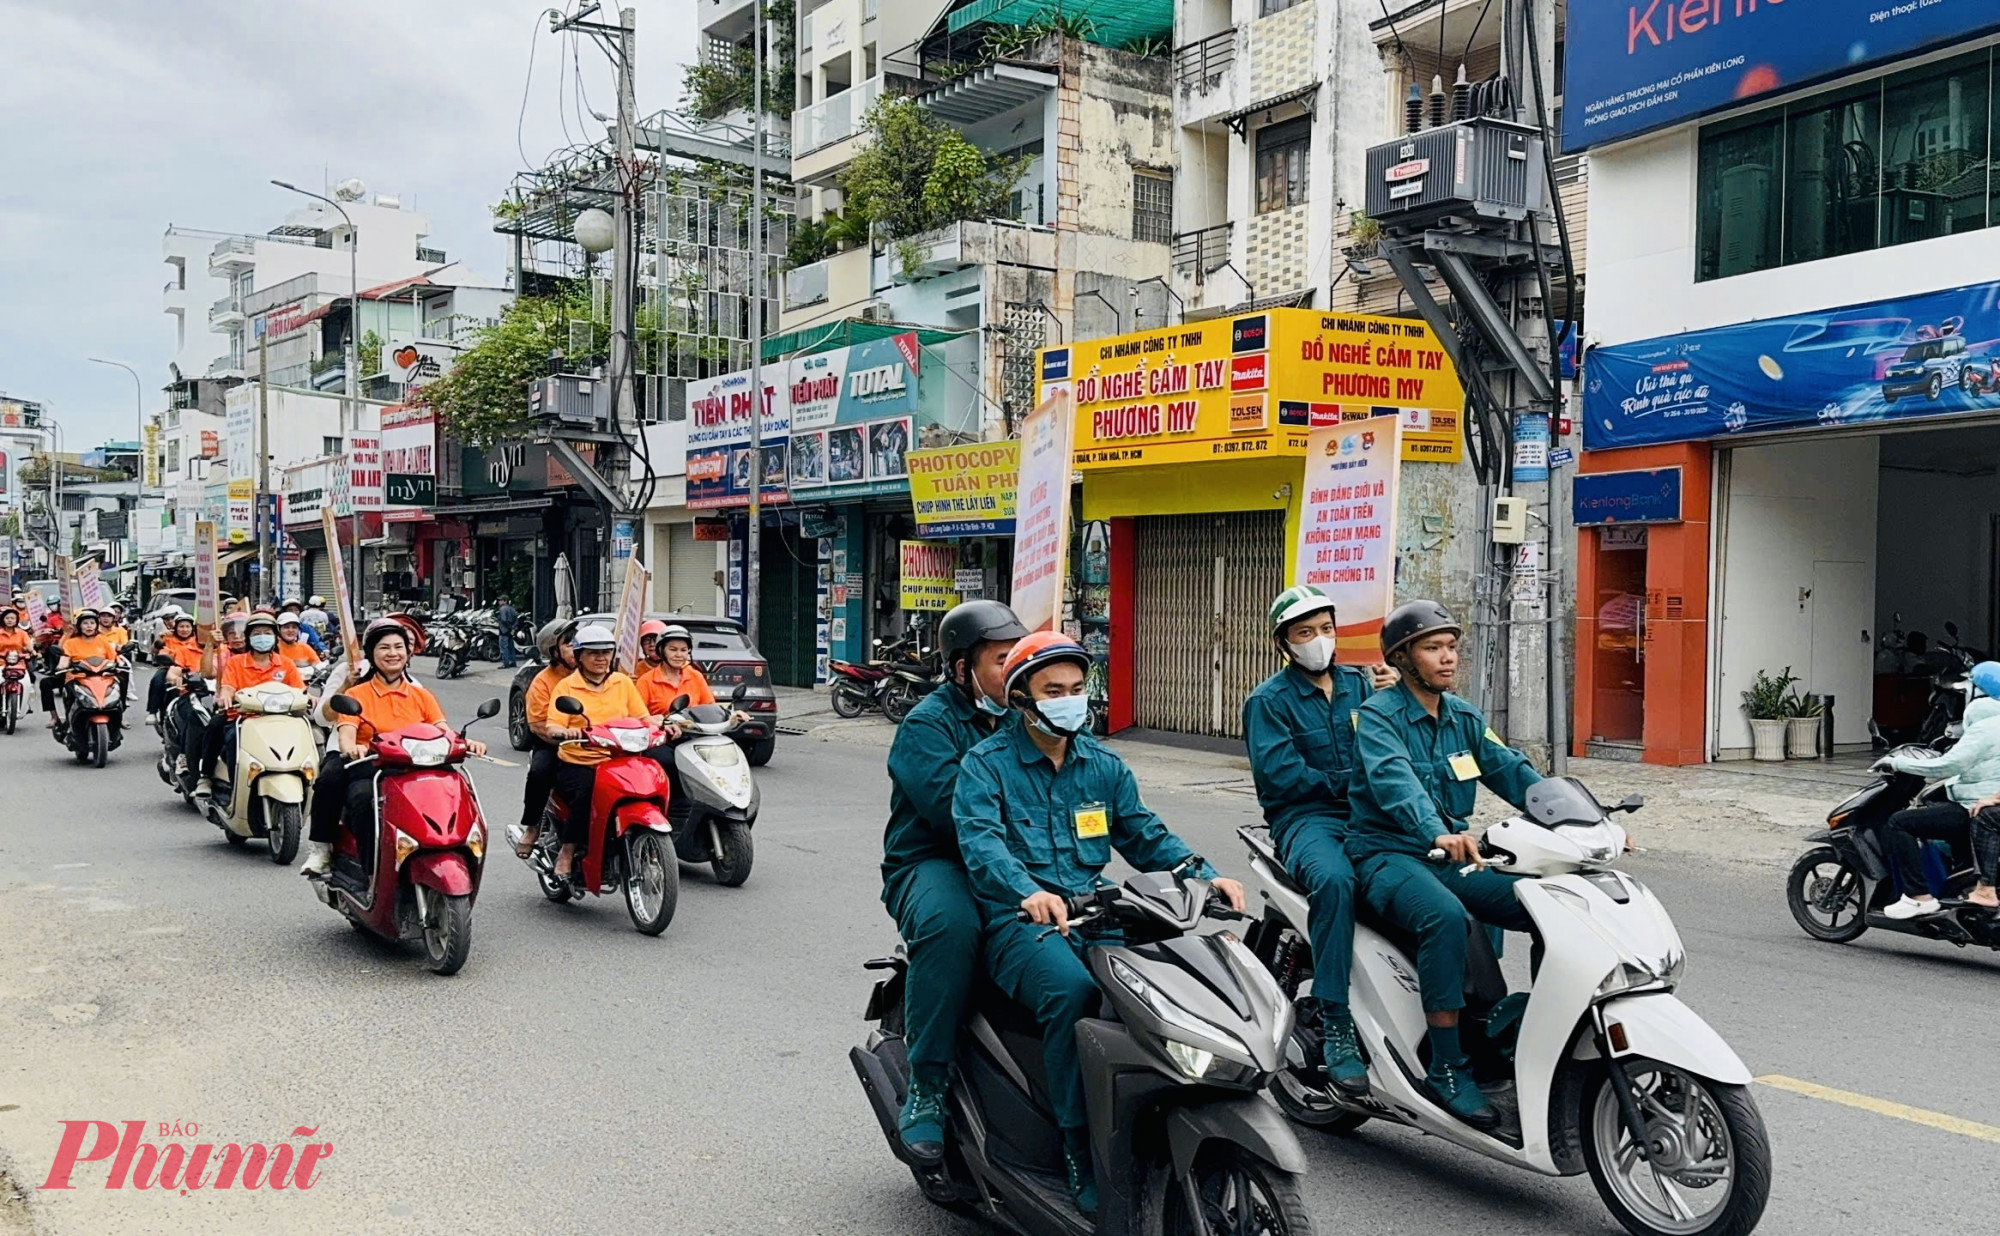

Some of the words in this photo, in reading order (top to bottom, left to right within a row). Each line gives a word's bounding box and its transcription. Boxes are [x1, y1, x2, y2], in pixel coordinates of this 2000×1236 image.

[1870, 10, 1890, 23] Điện
[1585, 99, 1604, 115] NGÂN
[1605, 93, 1625, 110] HÀNG
[1626, 83, 1656, 101] THƯƠNG
[1656, 79, 1670, 92] MẠI
[1670, 73, 1683, 87] CỔ
[1684, 67, 1704, 82] PHẦN
[1704, 61, 1722, 76] KIÊN
[1722, 55, 1745, 70] LONG
[1584, 112, 1608, 127] PHÒNG
[1610, 106, 1628, 120] GIAO
[1628, 100, 1646, 114] DỊCH
[1646, 94, 1663, 108] ĐẦM
[1664, 90, 1678, 102] SEN
[1244, 328, 1264, 339] BOSCH
[1322, 317, 1336, 330] CHI
[1337, 316, 1366, 332] NHÁNH
[1368, 320, 1390, 336] CÔNG
[1392, 323, 1402, 336] TY
[1404, 324, 1424, 338] TNHH
[898, 338, 916, 367] TOTAL
[1100, 342, 1112, 360] CHI
[1114, 337, 1140, 358] NHÁNH
[1143, 335, 1164, 354] CÔNG
[1167, 334, 1177, 350] TY
[1181, 332, 1202, 348] TNHH
[1302, 334, 1324, 362] ĐỒ
[1328, 338, 1371, 366] NGHỀ
[1376, 341, 1412, 369] CẦM
[1417, 350, 1444, 370] TAY
[850, 362, 906, 398] TOTAL
[1077, 364, 1100, 404] ĐỒ
[1101, 358, 1146, 400] NGHỀ
[1150, 354, 1188, 395] CẦM
[1194, 359, 1227, 389] TAY
[1322, 372, 1390, 399] PHƯƠNG
[1397, 378, 1424, 400] MY
[692, 385, 726, 427] TIẾN
[1232, 406, 1262, 418] TOLSEN
[1092, 404, 1162, 440] PHƯƠNG
[1168, 400, 1198, 433] MY
[1432, 416, 1456, 425] TOLSEN
[351, 438, 370, 449] TRANG
[370, 437, 380, 448] TRÍ
[909, 448, 1016, 474] PHOTOCOPY
[352, 470, 366, 487] NAM
[368, 470, 381, 487] ANH
[931, 471, 980, 494] TUẤN
[1310, 486, 1328, 504] BÌNH
[1354, 480, 1370, 500] GIỚI
[1373, 480, 1384, 497] VÀ
[1580, 493, 1662, 510] KienlongBank
[1316, 509, 1328, 523] AN
[1330, 506, 1350, 522] TOÀN
[1353, 502, 1373, 520] TRÊN
[1305, 526, 1331, 544] KHÔNG
[1333, 527, 1352, 542] GIAN
[1355, 524, 1381, 542] MẠNG
[1307, 567, 1331, 584] CHÍNH
[1333, 565, 1361, 583] CHÚNG
[1364, 566, 1375, 581] TA
